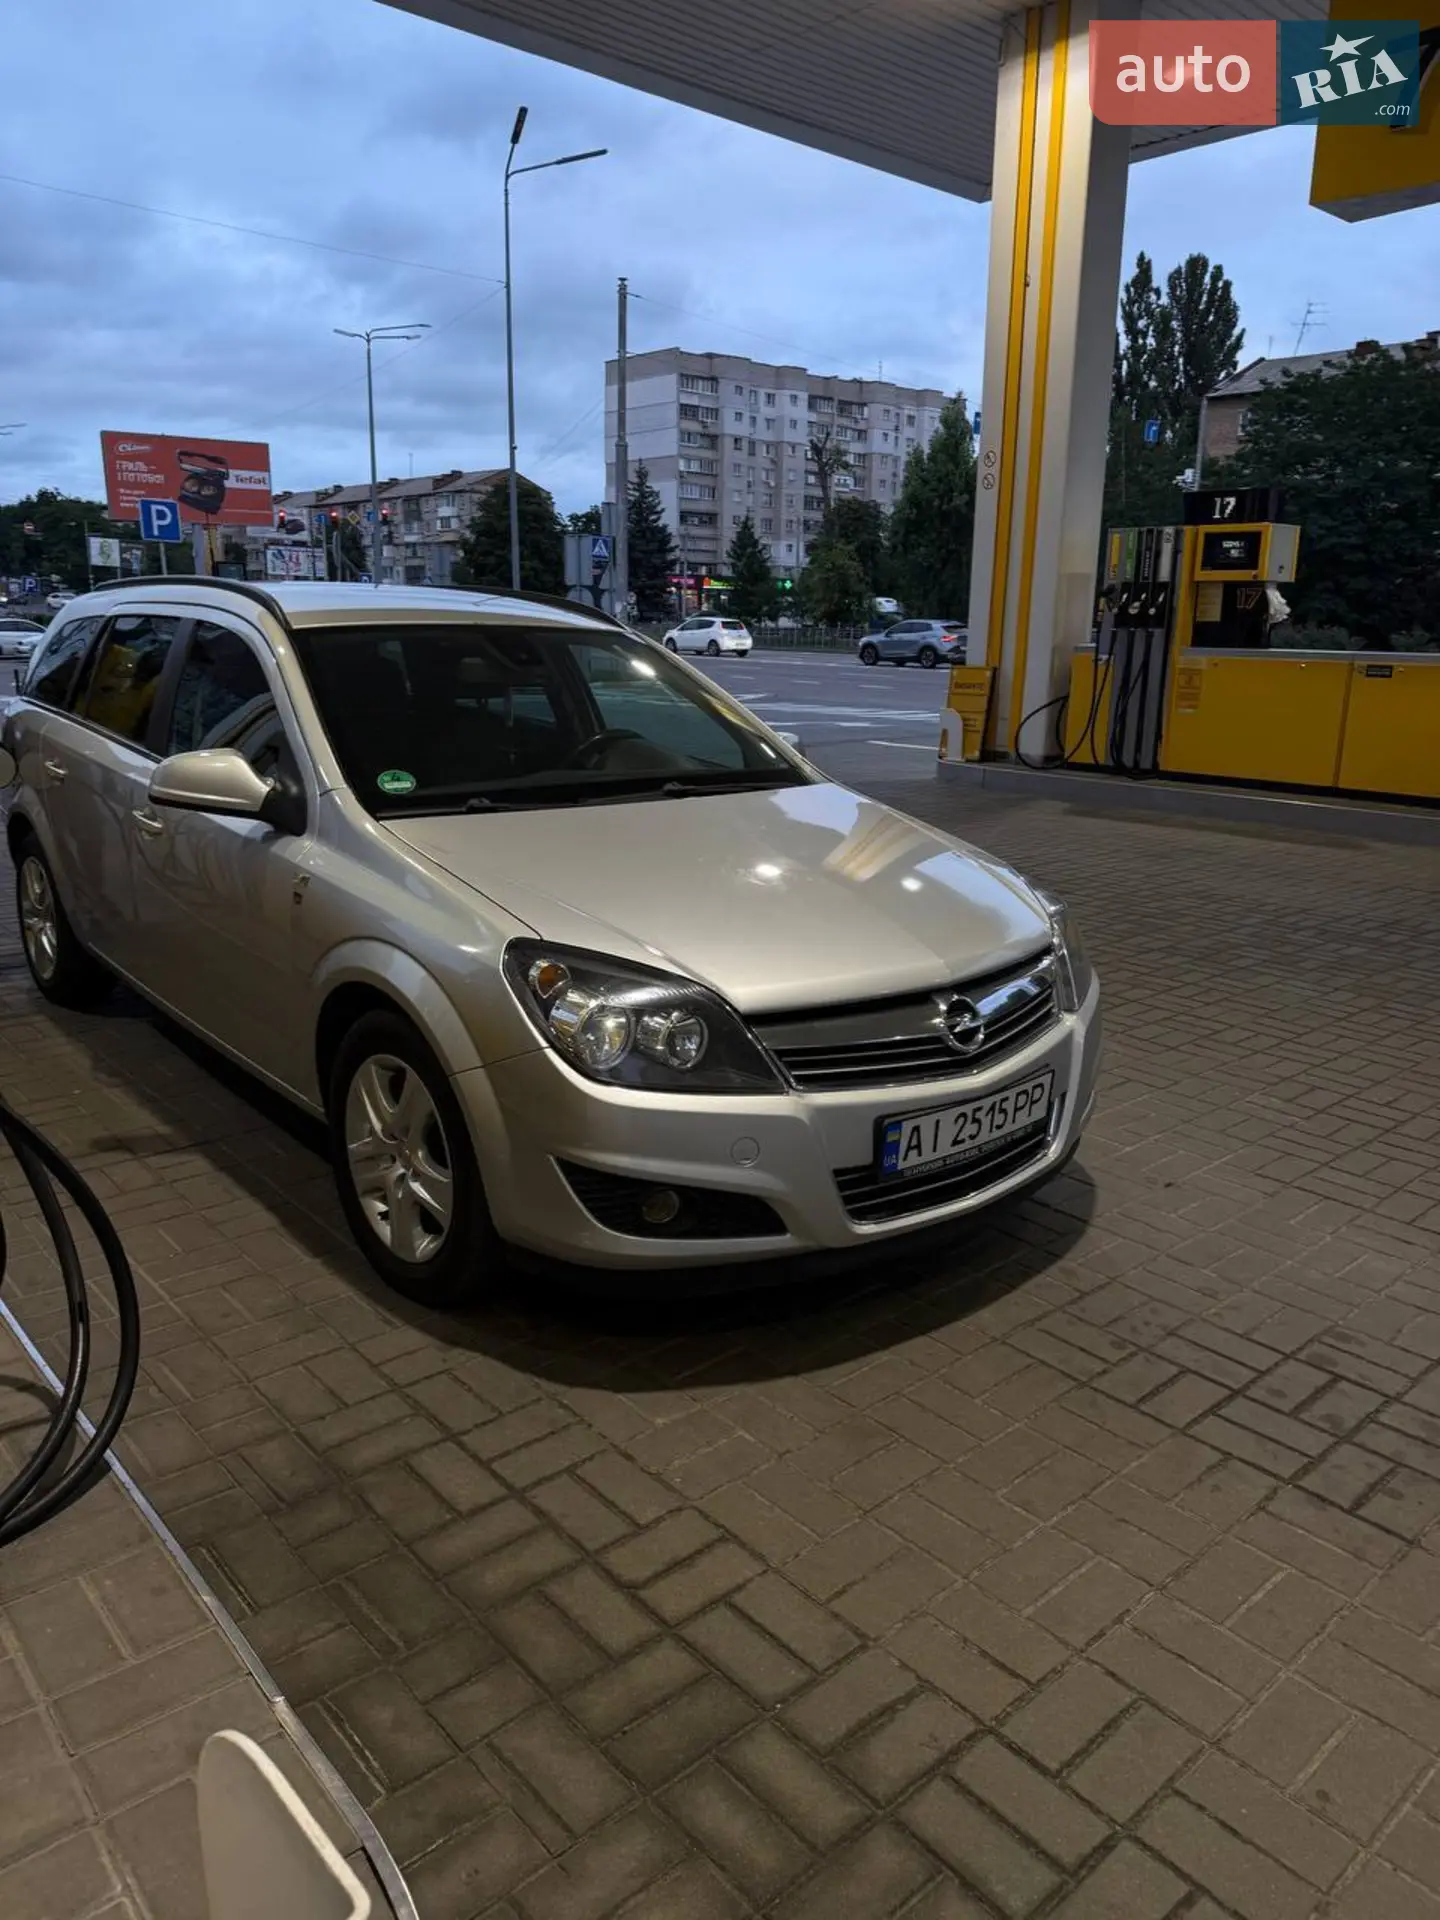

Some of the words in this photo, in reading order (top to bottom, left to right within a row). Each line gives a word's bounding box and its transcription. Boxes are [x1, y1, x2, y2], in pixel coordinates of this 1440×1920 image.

[150, 504, 172, 536] P
[1212, 496, 1237, 519] 17
[1235, 587, 1263, 610] 17
[902, 1119, 940, 1161] AI
